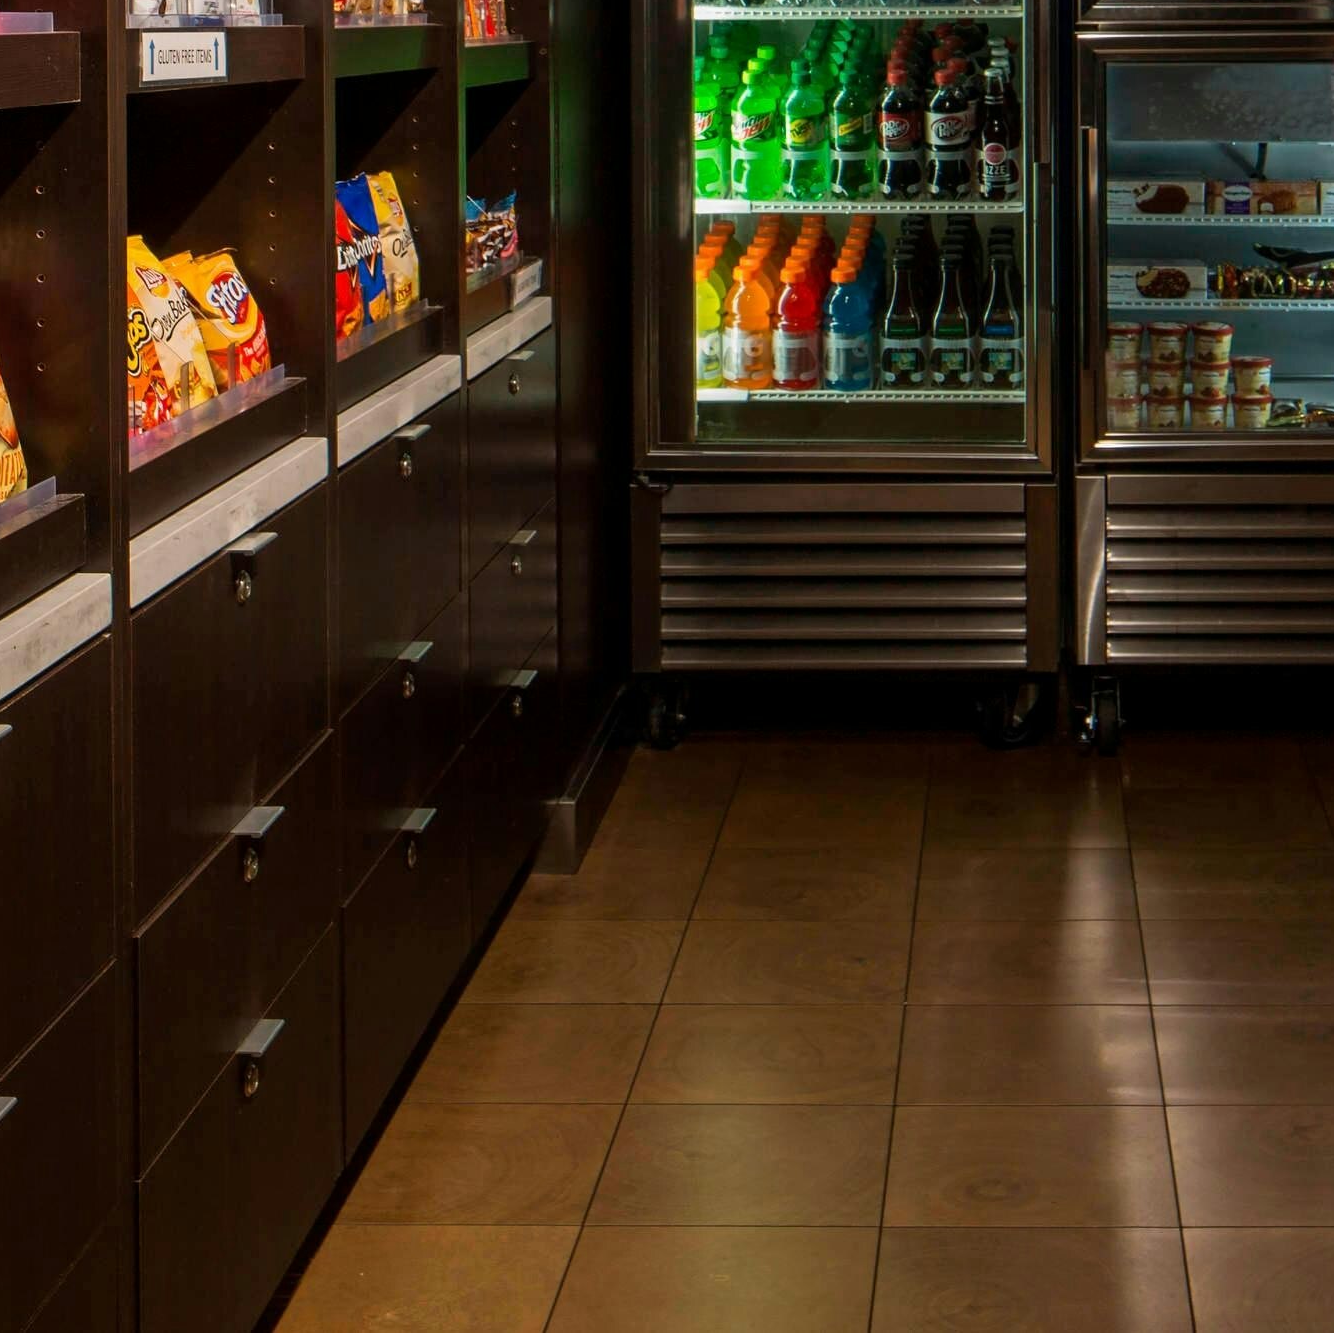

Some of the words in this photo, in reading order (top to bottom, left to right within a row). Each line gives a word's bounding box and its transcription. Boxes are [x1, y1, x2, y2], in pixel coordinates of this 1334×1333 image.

[157, 49, 180, 65] GLUTEN
[181, 49, 195, 64] FREE
[195, 49, 212, 64] ITEMS
